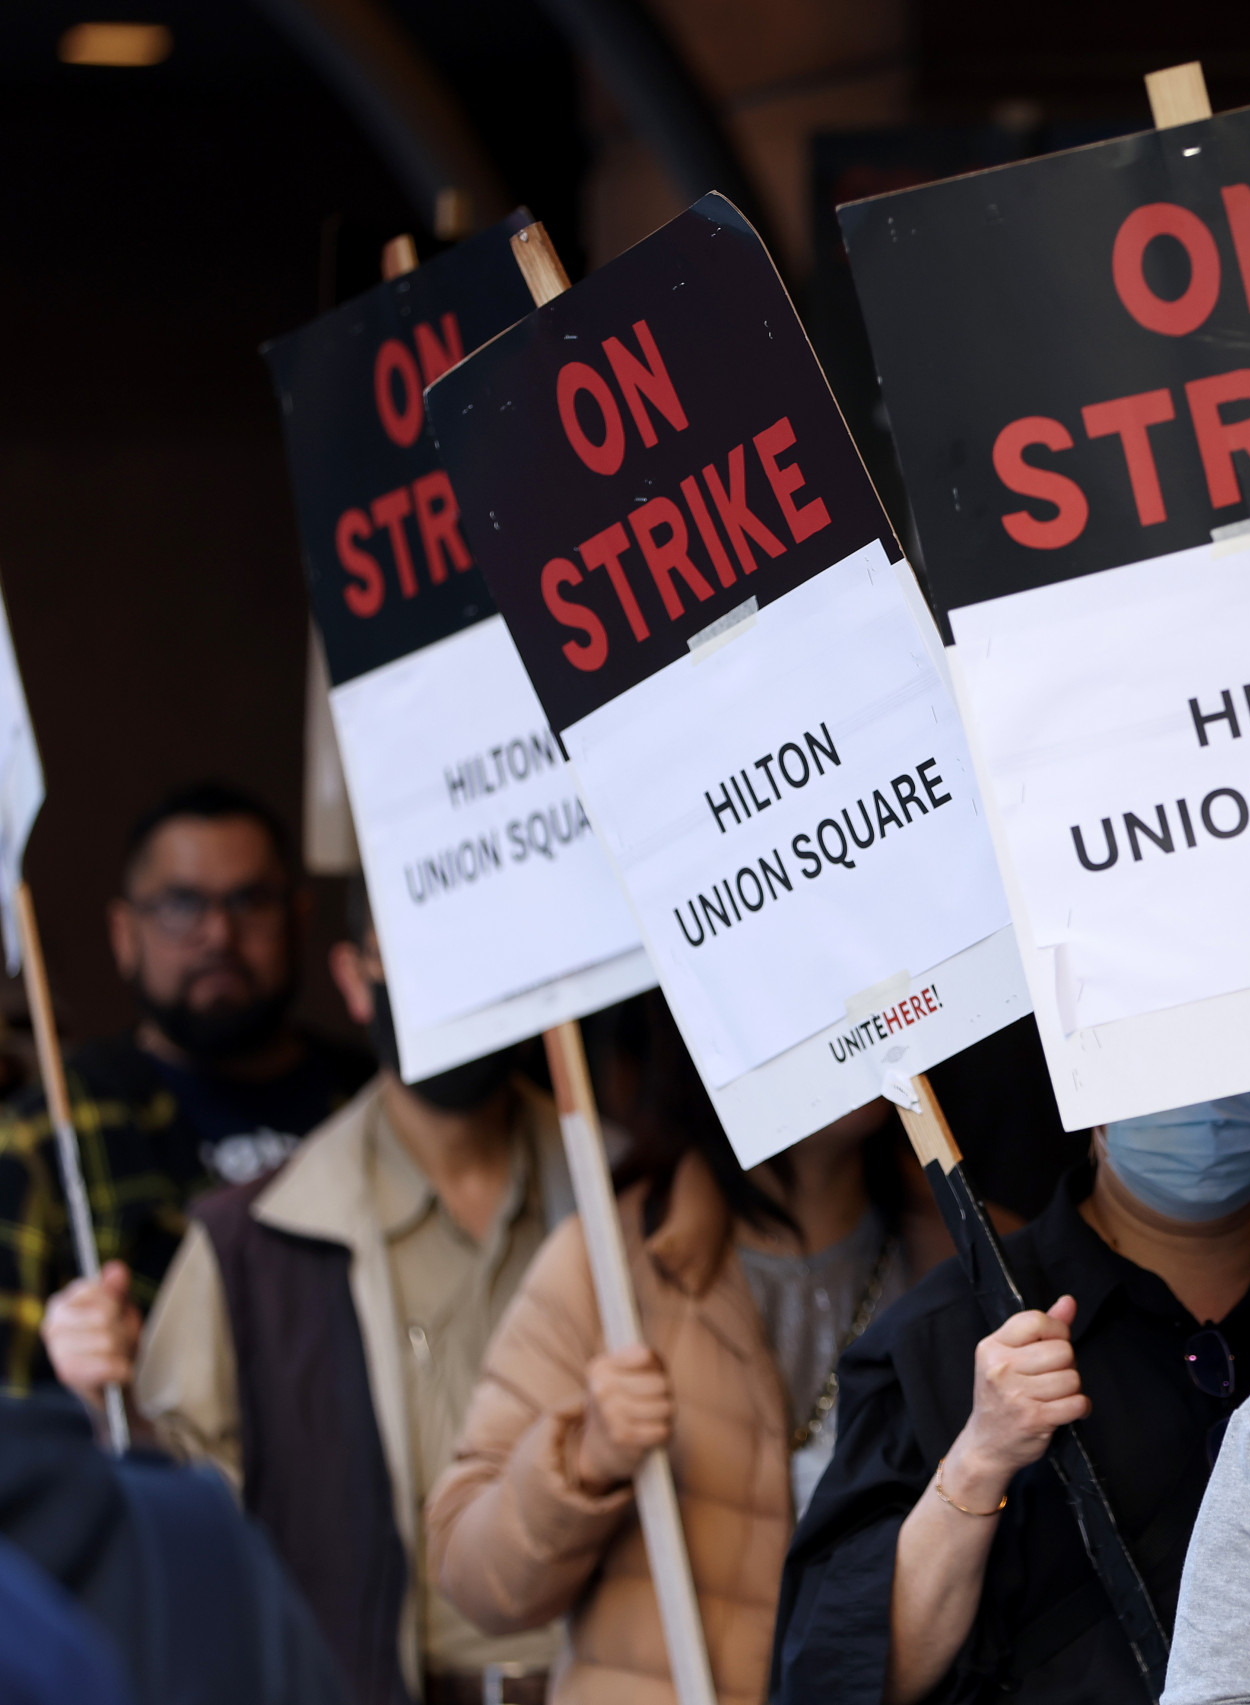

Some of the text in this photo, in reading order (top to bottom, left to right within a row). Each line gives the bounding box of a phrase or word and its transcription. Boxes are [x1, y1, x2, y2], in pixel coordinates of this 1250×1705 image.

[374, 312, 466, 448] ON
[557, 319, 689, 476] ON
[335, 469, 472, 619] STR
[541, 417, 832, 672] STRIKE
[444, 730, 555, 807] HILTON
[704, 722, 842, 833] HILTON
[404, 797, 596, 904] UNION SQUA
[674, 757, 953, 948] UNION SQUARE
